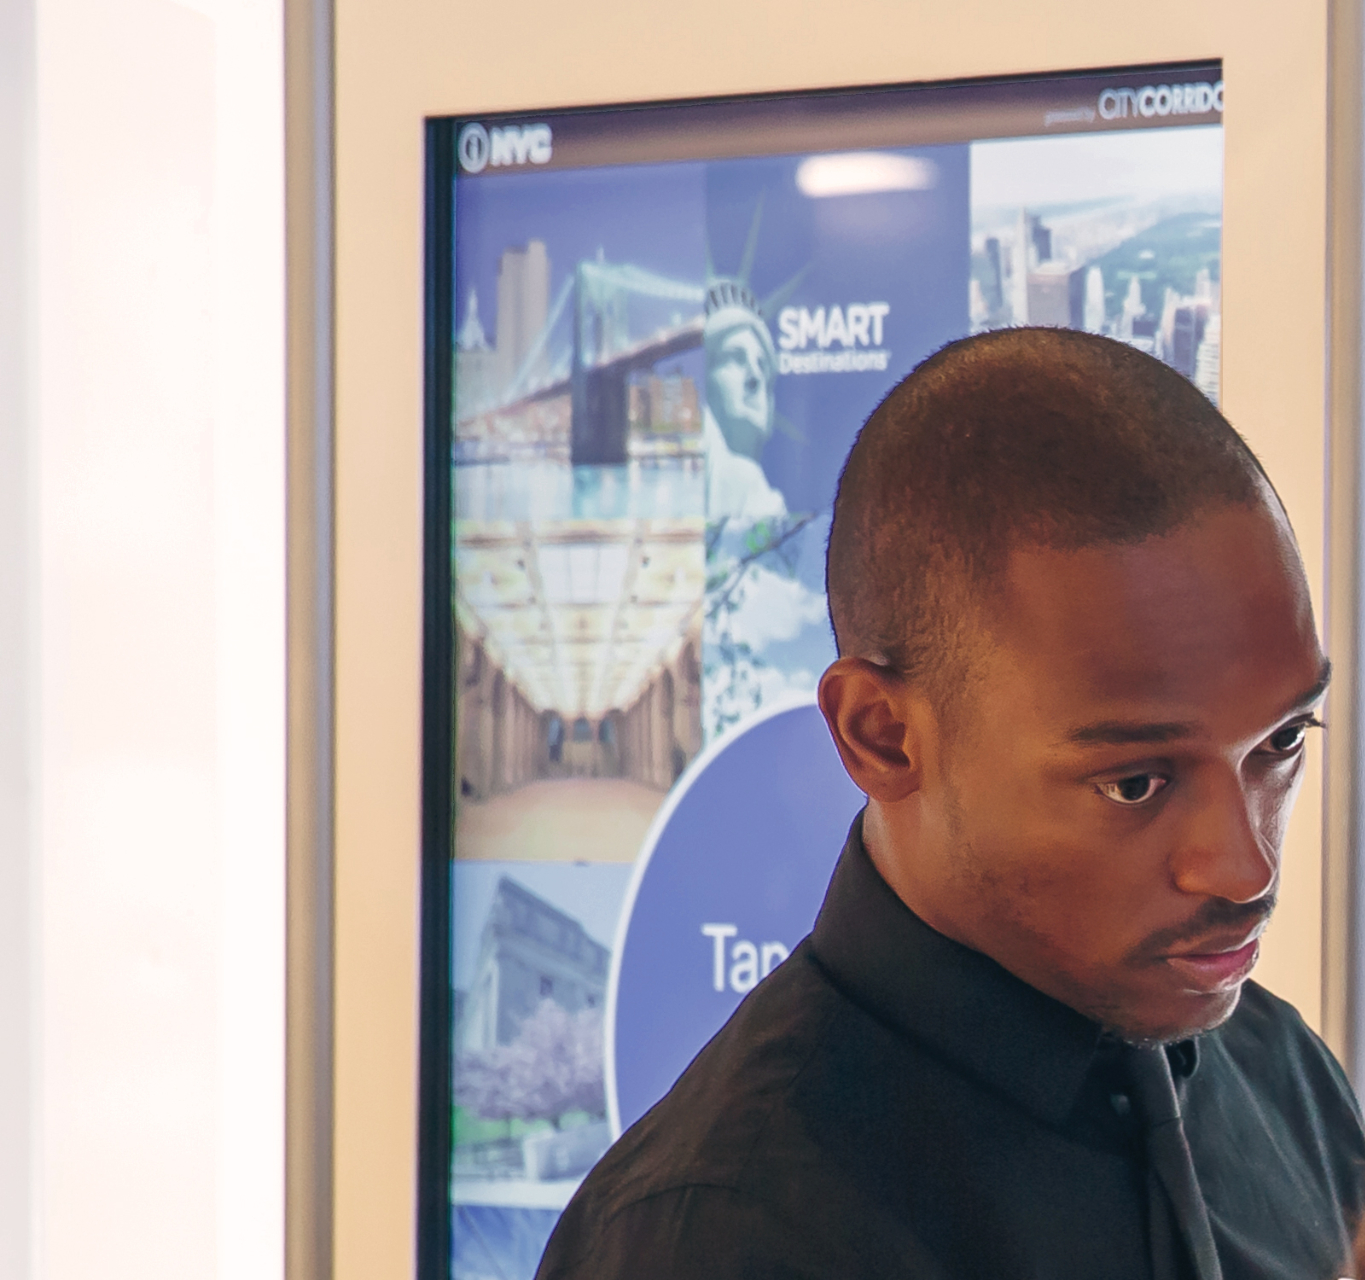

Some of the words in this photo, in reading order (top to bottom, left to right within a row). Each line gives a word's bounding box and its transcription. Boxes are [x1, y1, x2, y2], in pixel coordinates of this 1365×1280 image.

[489, 123, 552, 166] NYC
[778, 302, 890, 349] SMART
[779, 349, 890, 374] Destinations
